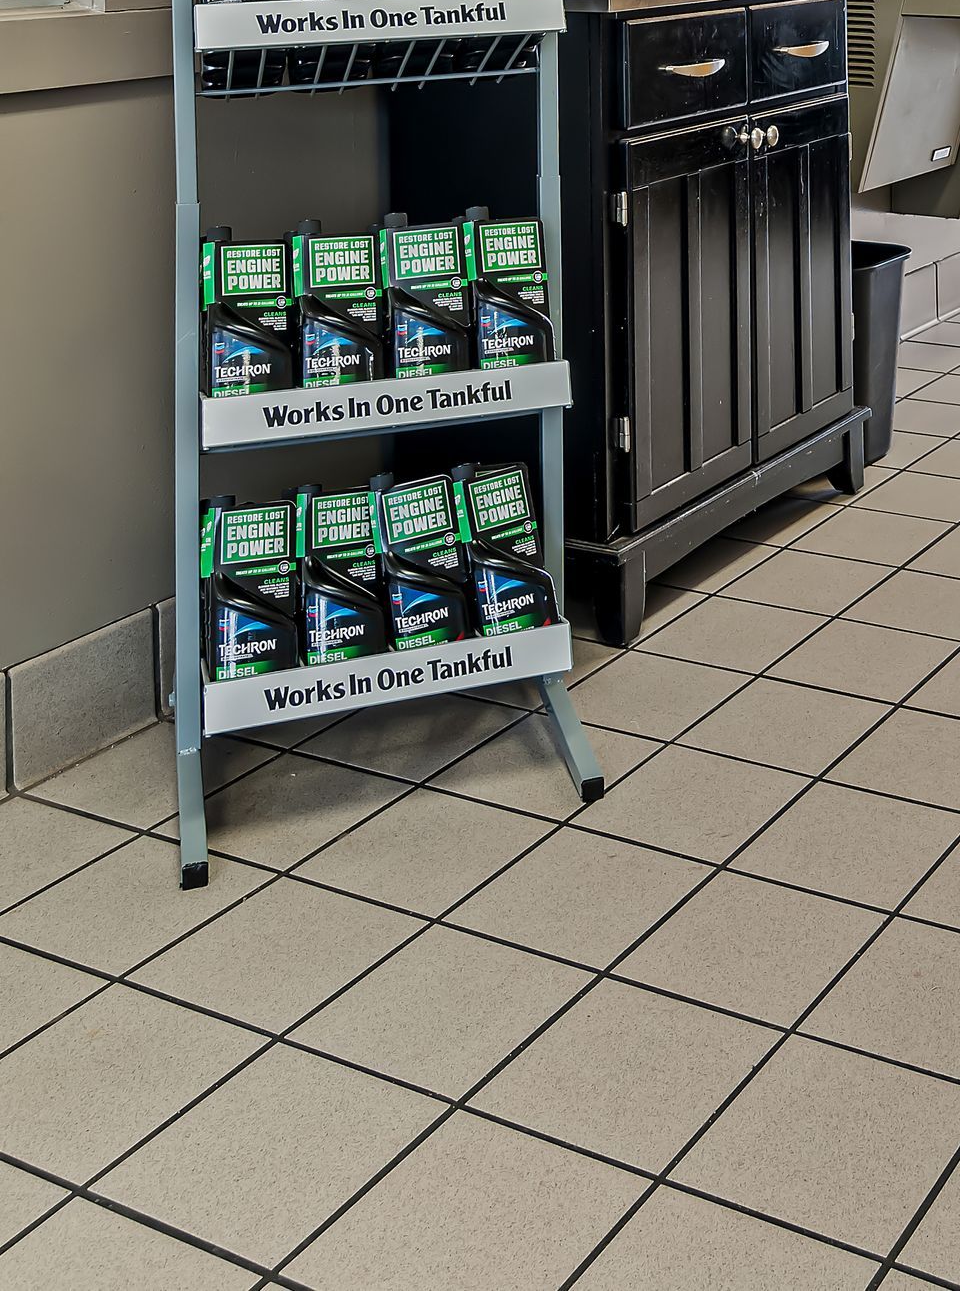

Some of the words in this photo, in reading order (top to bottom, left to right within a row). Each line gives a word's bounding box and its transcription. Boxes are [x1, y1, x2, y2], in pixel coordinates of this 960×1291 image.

[255, 11, 339, 35] Works
[341, 10, 365, 30] In
[369, 8, 418, 29] One
[420, 2, 507, 26] Tankful
[398, 234, 432, 244] RESTORE
[434, 231, 453, 240] LOST
[484, 227, 517, 237] RESTORE
[517, 225, 535, 235] LOST
[314, 241, 349, 251] RESTORE
[350, 240, 369, 249] LOST
[399, 240, 454, 259] ENGINE
[485, 235, 536, 252] ENGINE
[227, 249, 260, 259] RESTORE
[262, 248, 281, 257] LOST
[315, 250, 369, 266] ENGINE
[486, 250, 537, 268] POWER
[227, 258, 281, 274] ENGINE
[400, 255, 456, 275] POWER
[227, 273, 281, 291] POWER
[315, 266, 371, 283] POWER
[481, 334, 535, 349] TECHRON
[397, 344, 452, 359] TECHRON
[305, 354, 361, 369] TECHRON
[483, 358, 520, 370] DIESEL
[214, 363, 272, 379] TECHRON
[262, 401, 345, 428] Works
[348, 397, 371, 418] In
[376, 394, 424, 416] One
[425, 379, 513, 410] Tankful
[473, 482, 503, 495] RESTORE
[503, 475, 520, 488] LOST
[317, 498, 350, 510] RESTORE
[351, 496, 370, 506] LOST
[388, 491, 422, 506] RESTORE
[423, 485, 442, 498] LOST
[476, 484, 522, 510] ENGINE
[227, 513, 263, 525] RESTORE
[265, 510, 285, 520] LOST
[317, 506, 371, 526] ENGINE
[389, 495, 445, 522] ENGINE
[478, 502, 525, 526] POWER
[227, 521, 284, 541] ENGINE
[317, 522, 371, 543] POWER
[391, 511, 448, 538] POWER
[226, 538, 285, 559] POWER
[481, 593, 535, 616] TECHRON
[395, 606, 449, 629] TECHRON
[309, 624, 365, 643] TECHRON
[485, 620, 522, 637] DIESEL
[218, 639, 277, 657] TECHRON
[397, 633, 436, 650] DIESEL
[309, 651, 348, 666] DIESEL
[217, 667, 258, 681] DIESEL
[263, 678, 346, 711] Works
[348, 673, 372, 696] In
[376, 667, 425, 691] One
[426, 645, 513, 681] Tankful
